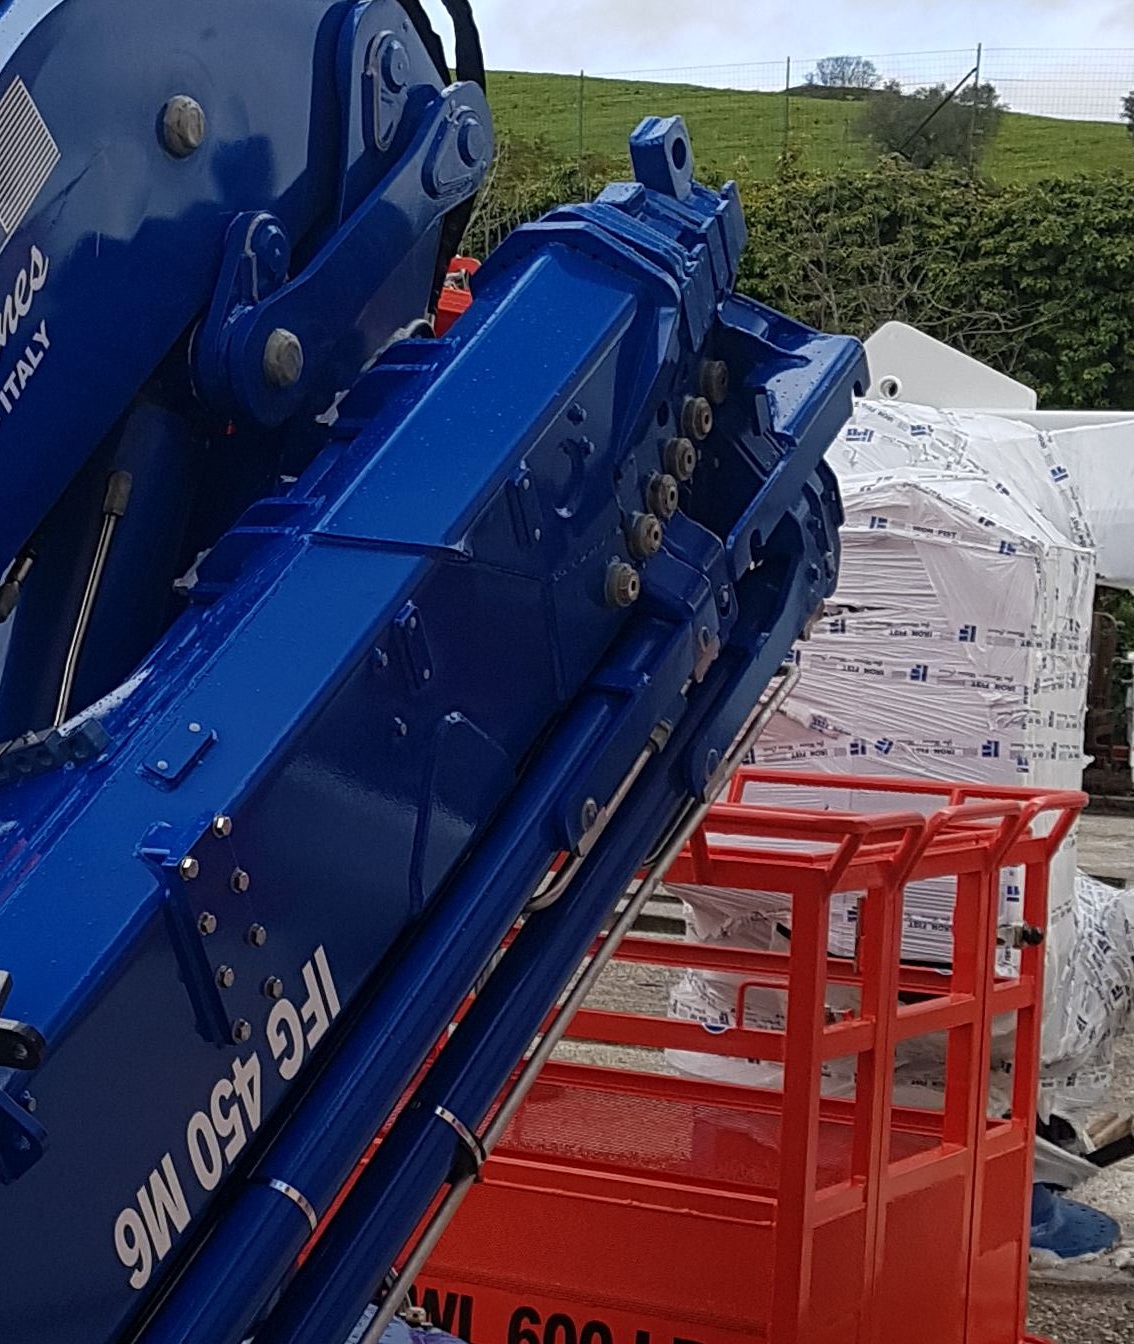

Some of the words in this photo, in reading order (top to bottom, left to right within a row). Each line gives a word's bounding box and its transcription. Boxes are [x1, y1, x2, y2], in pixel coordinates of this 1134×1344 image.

[0, 320, 53, 413] ITALY
[266, 944, 341, 1081] IFG
[186, 1051, 261, 1192] 450
[114, 1152, 192, 1290] M6
